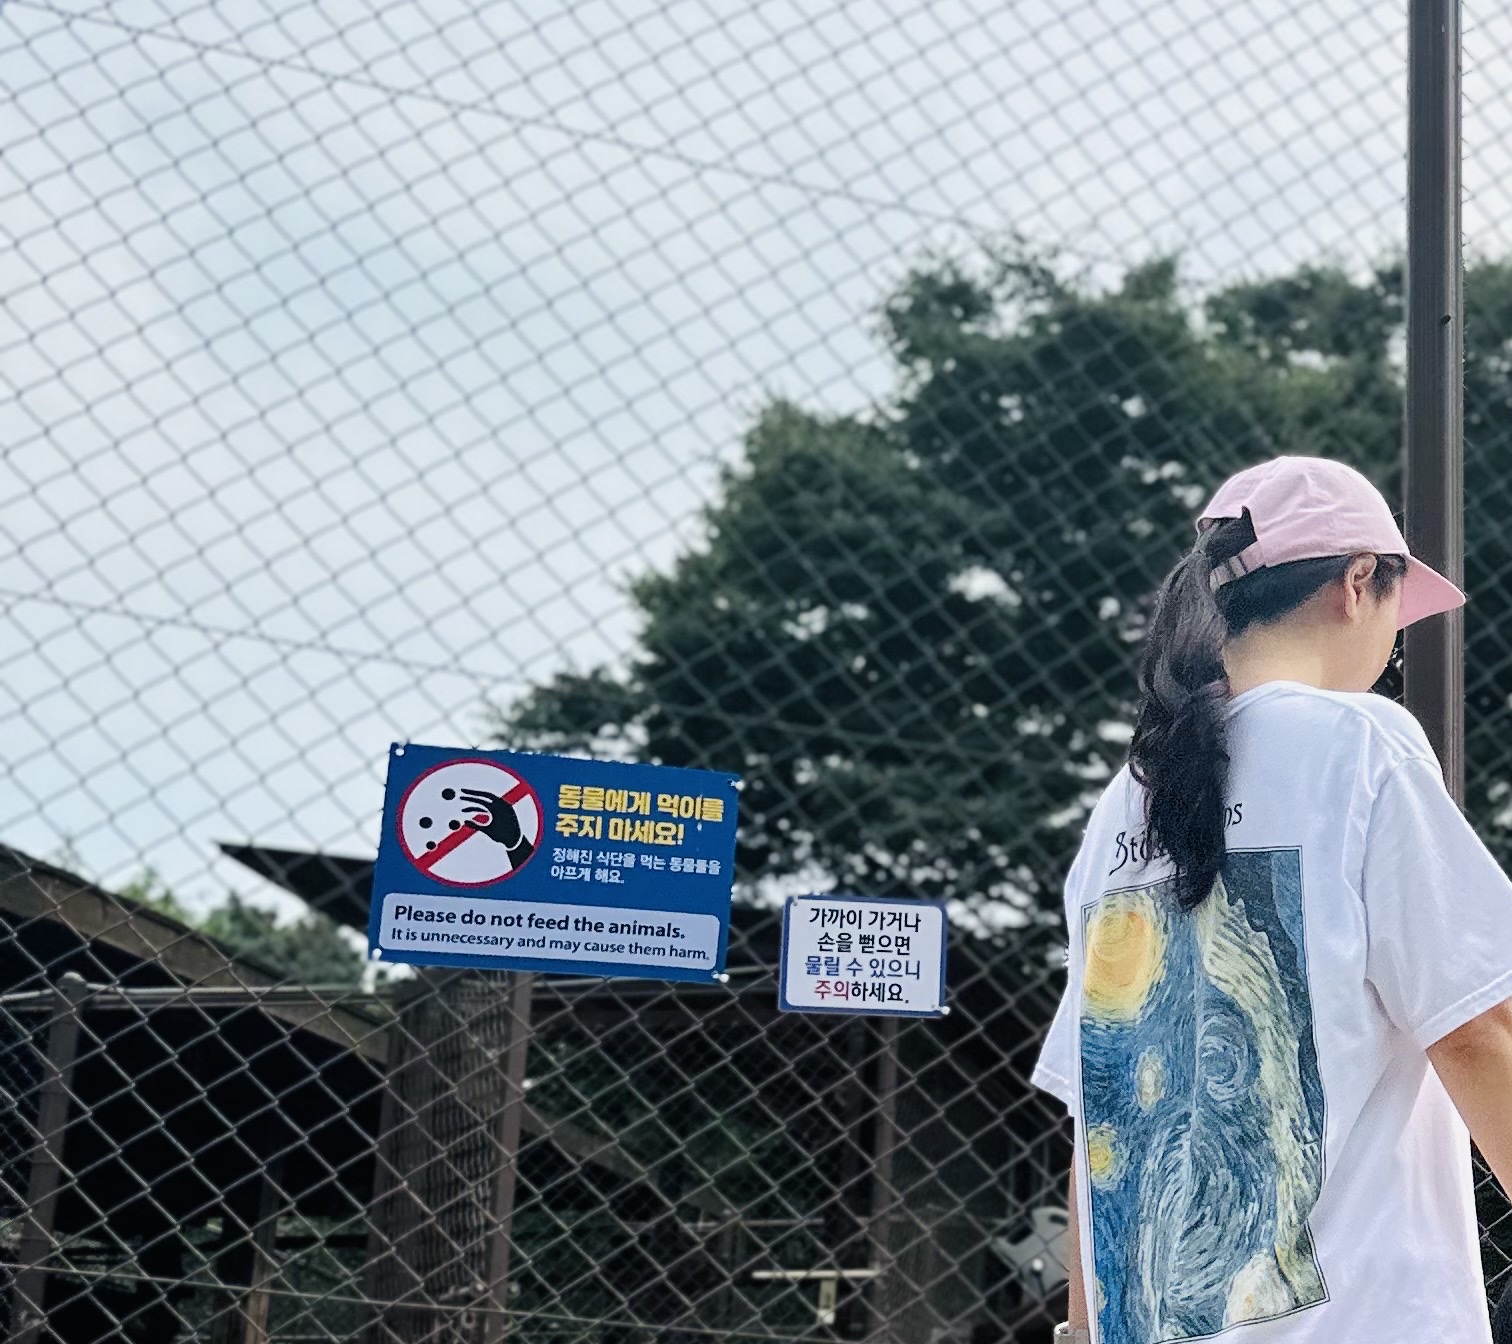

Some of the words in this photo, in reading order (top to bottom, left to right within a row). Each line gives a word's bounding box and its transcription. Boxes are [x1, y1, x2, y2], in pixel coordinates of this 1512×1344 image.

[558, 784, 652, 816] 동물에게
[656, 793, 725, 823] 먹이를
[555, 813, 603, 840] 주지
[608, 817, 686, 846] 마세요!
[552, 847, 593, 865] 정해진
[596, 851, 636, 869] 식단을
[640, 854, 667, 871] 먹는
[550, 865, 591, 883] 아프게
[594, 868, 625, 884] 해요.
[394, 905, 457, 924] Please
[461, 909, 486, 926] do
[491, 913, 523, 928] not
[527, 913, 570, 931] feed
[574, 916, 605, 933] the
[608, 920, 686, 940] animals.
[809, 907, 863, 929] 가까이
[868, 910, 922, 933] 가거나
[391, 927, 402, 940] It
[405, 927, 418, 941] is
[421, 931, 514, 950] unnecessary
[517, 936, 546, 949] and
[549, 939, 581, 954] may
[584, 941, 626, 954] cause
[628, 942, 666, 957] them
[669, 945, 710, 961] harm.
[817, 932, 853, 954] 손을
[858, 934, 911, 956] 뻗으면
[805, 955, 841, 977] 물릴
[845, 957, 864, 978] 수
[869, 958, 921, 981] 있으니
[814, 980, 910, 1004] 주의하세요.
